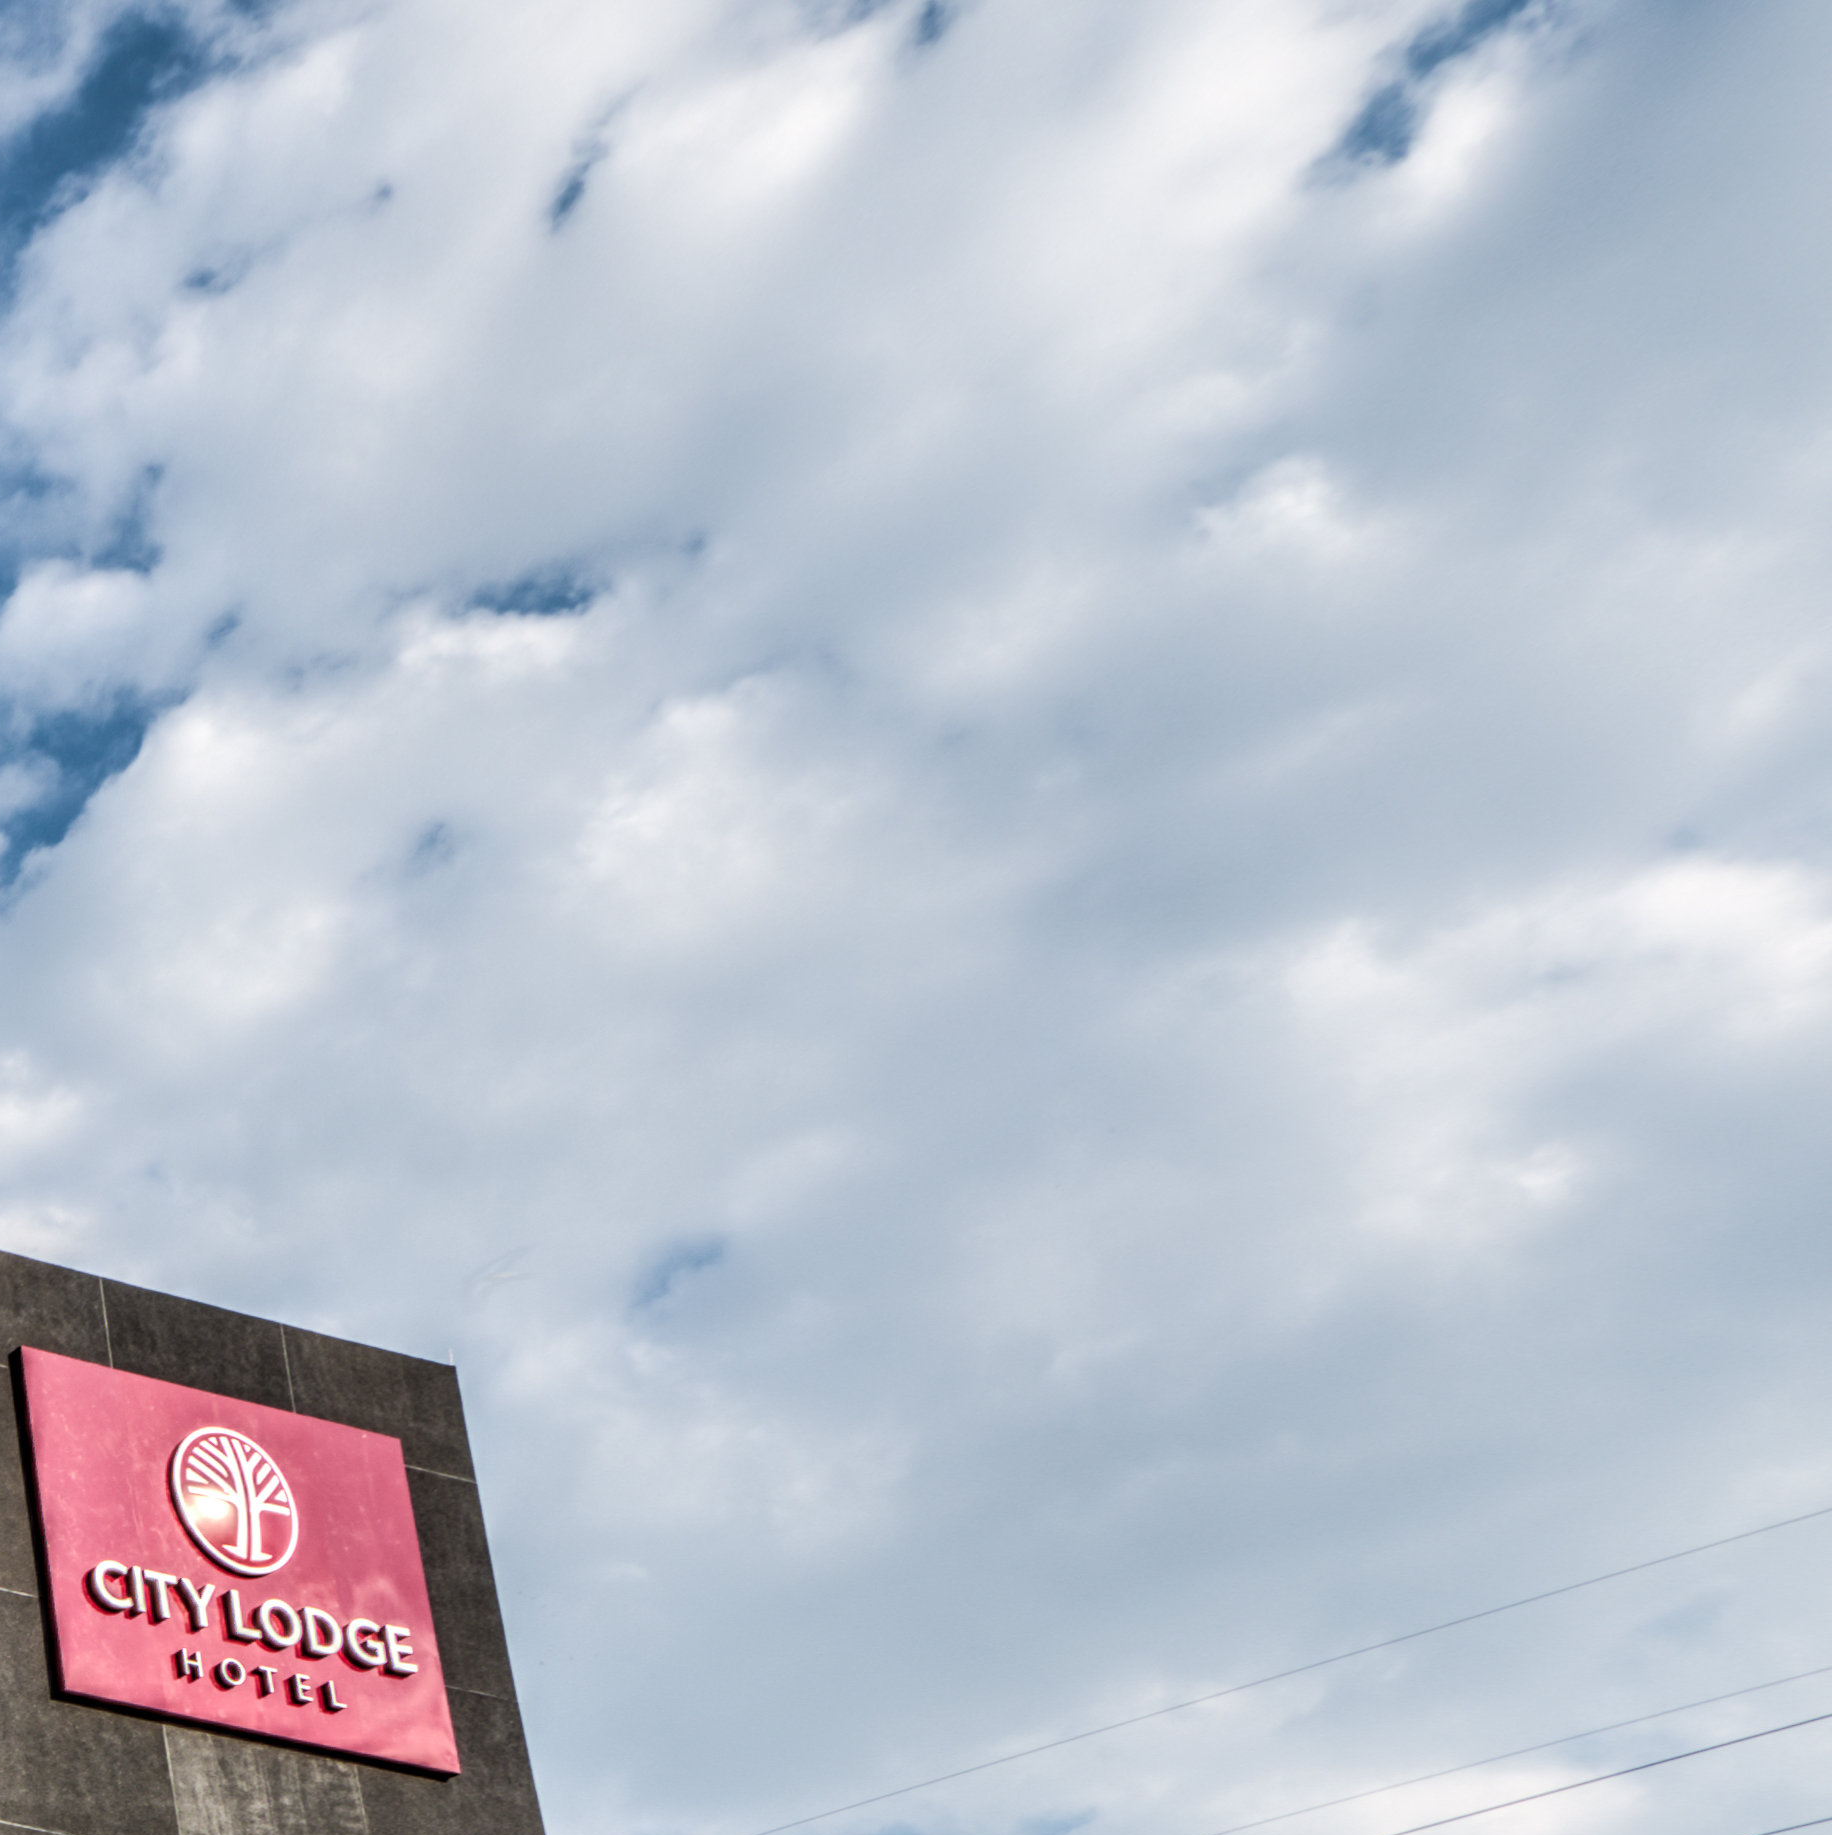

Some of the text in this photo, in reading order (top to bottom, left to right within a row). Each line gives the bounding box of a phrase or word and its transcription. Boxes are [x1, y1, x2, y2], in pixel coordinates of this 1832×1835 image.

[88, 1559, 419, 1675] CITY LODGE
[177, 1647, 348, 1711] HOTEL
